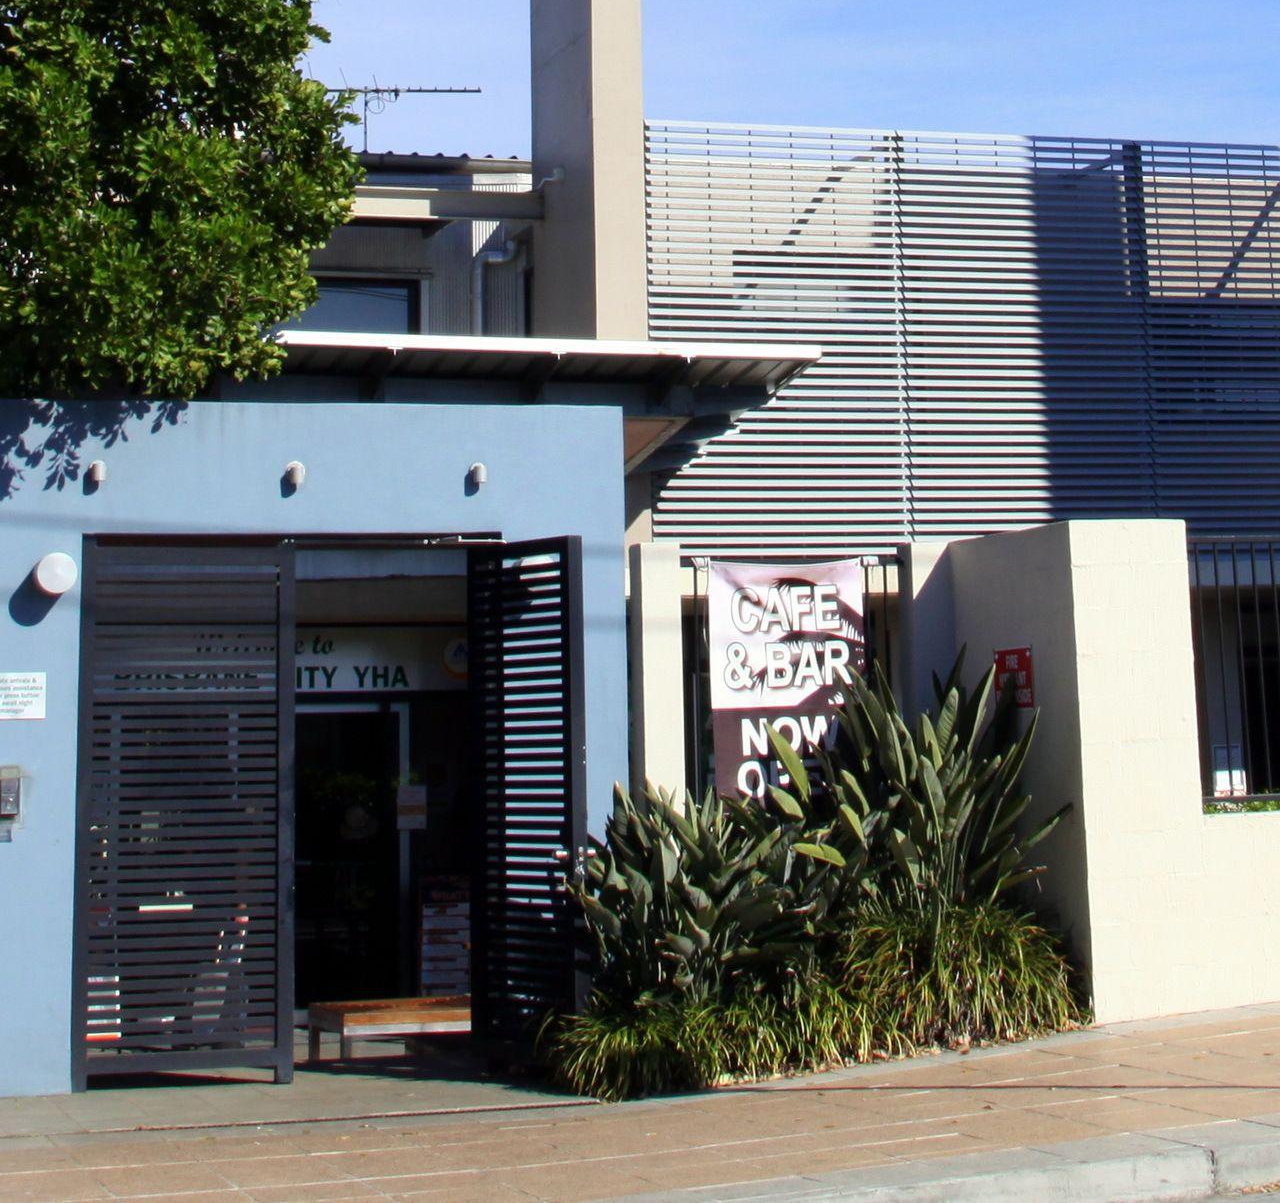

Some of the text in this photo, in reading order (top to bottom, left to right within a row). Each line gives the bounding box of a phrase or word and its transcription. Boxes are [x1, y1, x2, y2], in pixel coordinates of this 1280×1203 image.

[730, 583, 842, 634] CAFE
[312, 634, 335, 654] to
[295, 665, 409, 689] ITY YHA
[723, 640, 854, 691] & BAR
